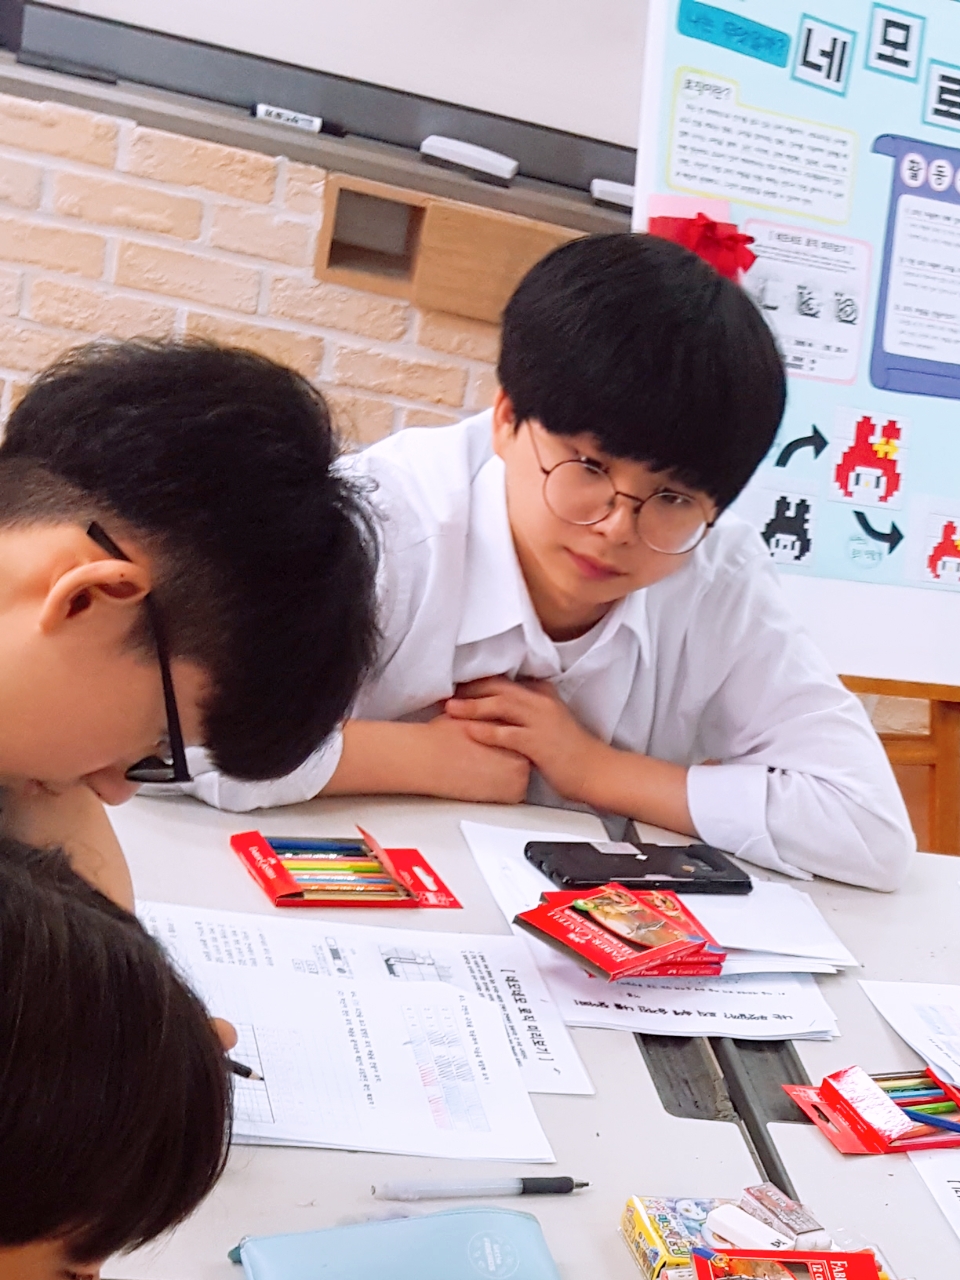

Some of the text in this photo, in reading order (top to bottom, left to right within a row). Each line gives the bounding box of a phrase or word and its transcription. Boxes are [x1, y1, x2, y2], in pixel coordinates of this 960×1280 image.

[505, 975, 527, 1003] 네모네모
[519, 1006, 536, 1021] 로직
[525, 1023, 551, 1052] 미리보기
[811, 1264, 823, 1272] 12
